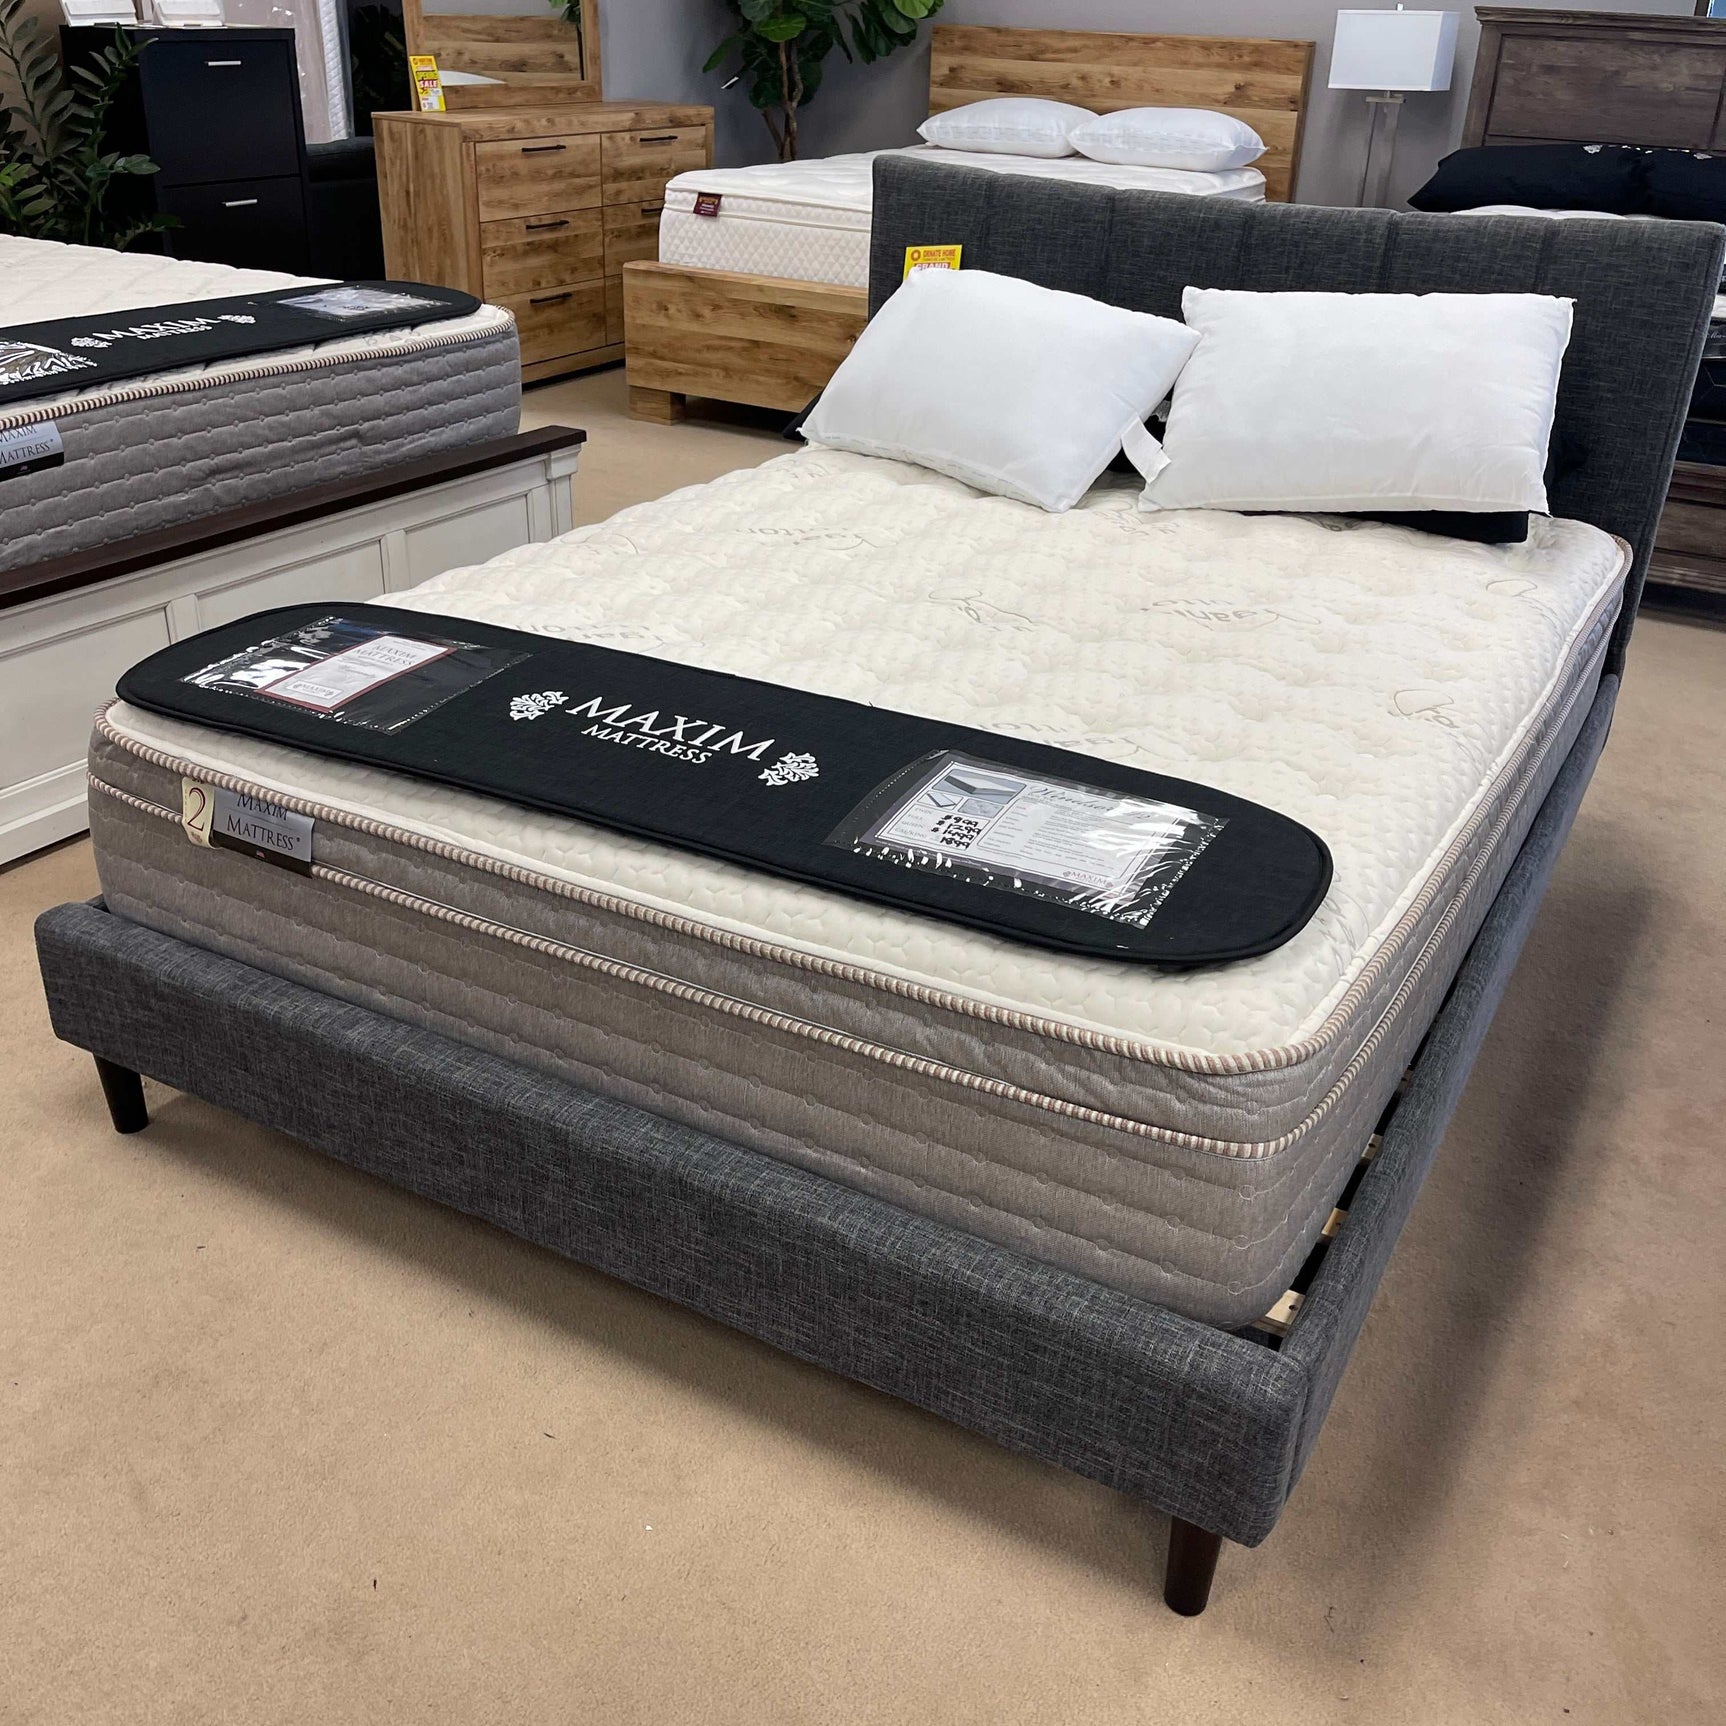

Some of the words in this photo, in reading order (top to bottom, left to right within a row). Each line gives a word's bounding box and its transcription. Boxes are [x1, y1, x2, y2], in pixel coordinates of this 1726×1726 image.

[92, 318, 221, 340] MAXIM
[565, 696, 775, 761] MAXIM
[581, 724, 712, 764] MATTRESS
[187, 787, 206, 832] 2
[237, 793, 289, 821] MAXIM
[227, 814, 294, 851] MATTRESS
